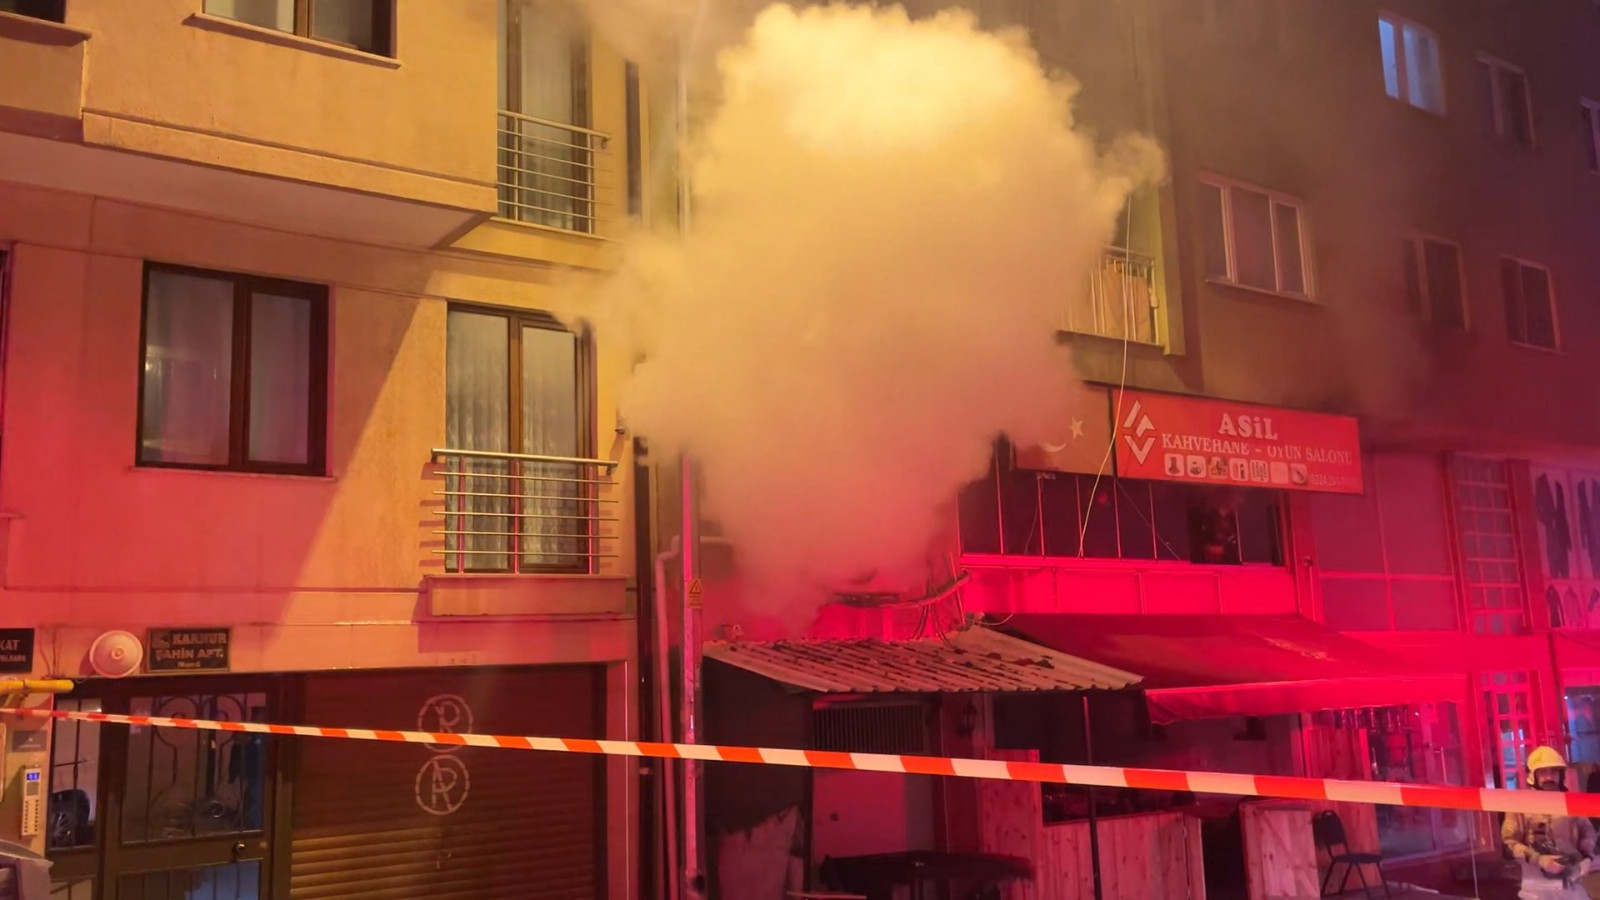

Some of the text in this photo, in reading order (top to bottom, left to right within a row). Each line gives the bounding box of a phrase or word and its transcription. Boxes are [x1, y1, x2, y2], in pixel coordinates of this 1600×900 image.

[1161, 432, 1250, 456] KAHVEHANE
[1267, 444, 1301, 461] OYUN
[1305, 446, 1353, 466] SALONU
[155, 647, 224, 661] ŞAHİN APT.
